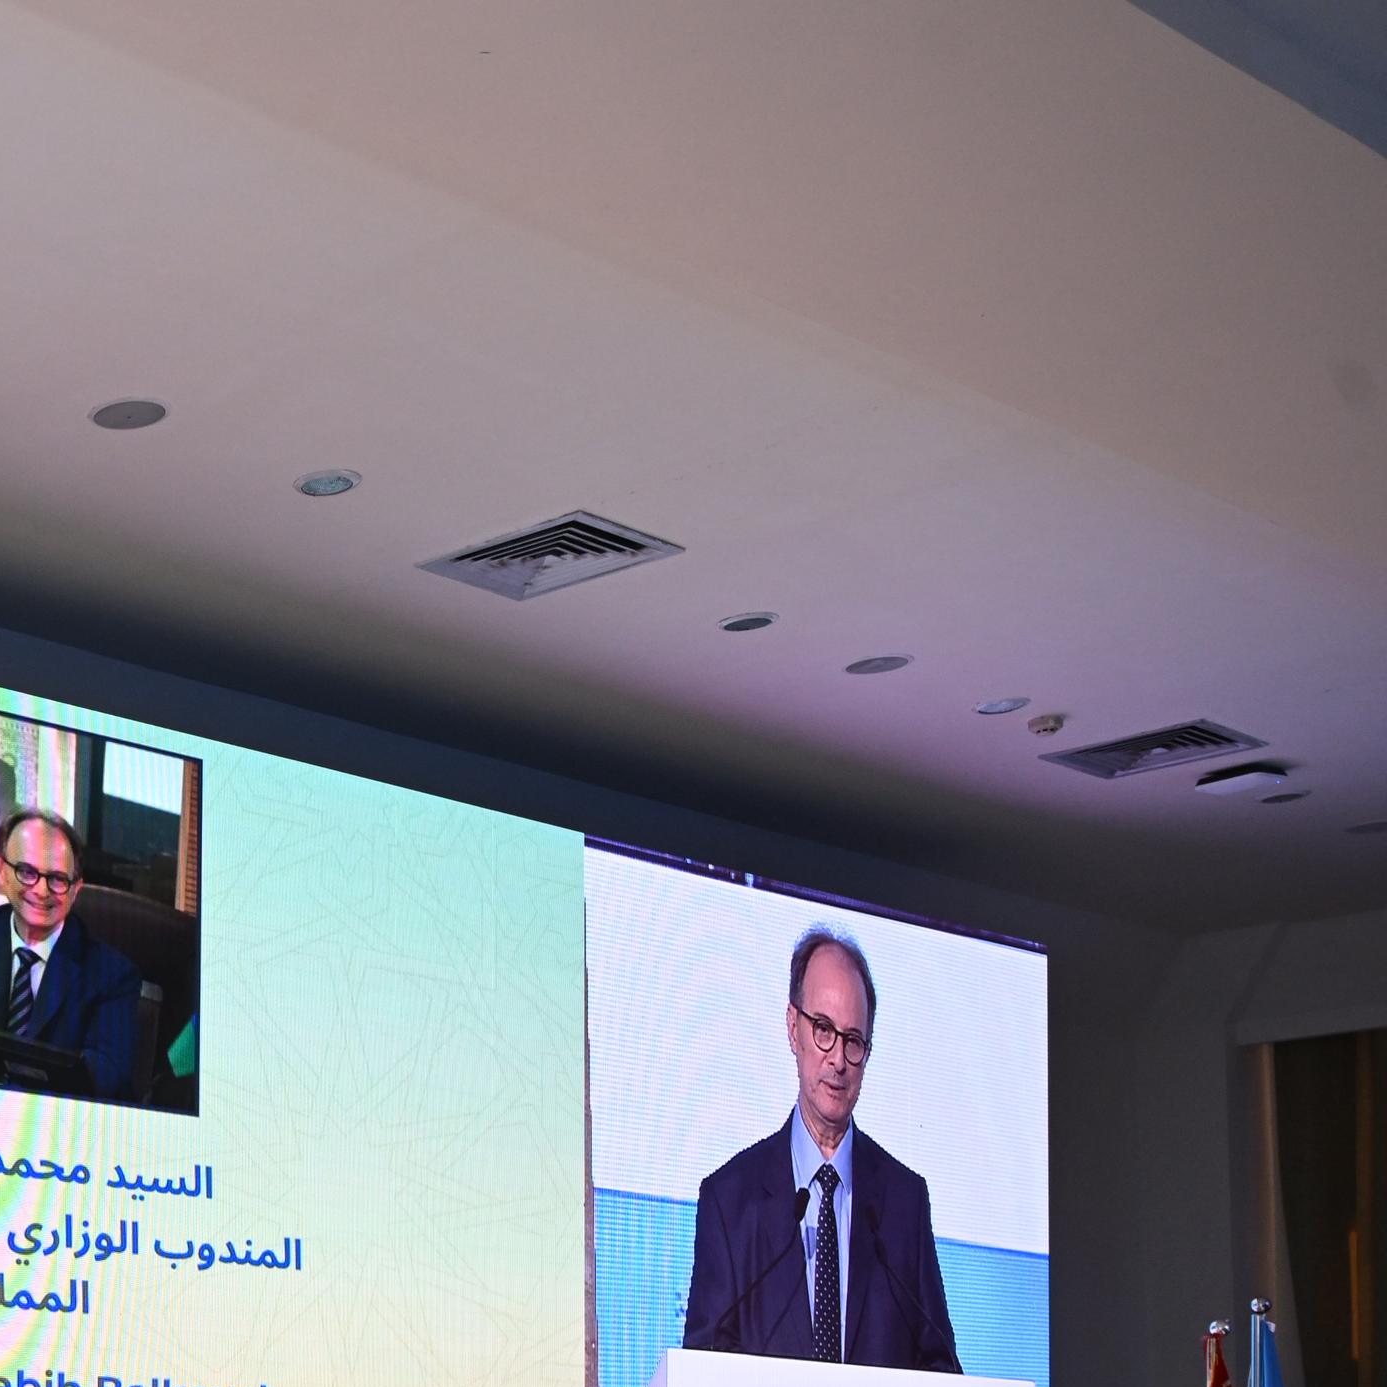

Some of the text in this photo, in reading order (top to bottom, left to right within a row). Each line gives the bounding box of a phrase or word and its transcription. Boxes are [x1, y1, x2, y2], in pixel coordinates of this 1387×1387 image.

[106, 1164, 214, 1205] السيد
[7, 1213, 140, 1267] الوزاري
[153, 1236, 303, 1275] المندوب
